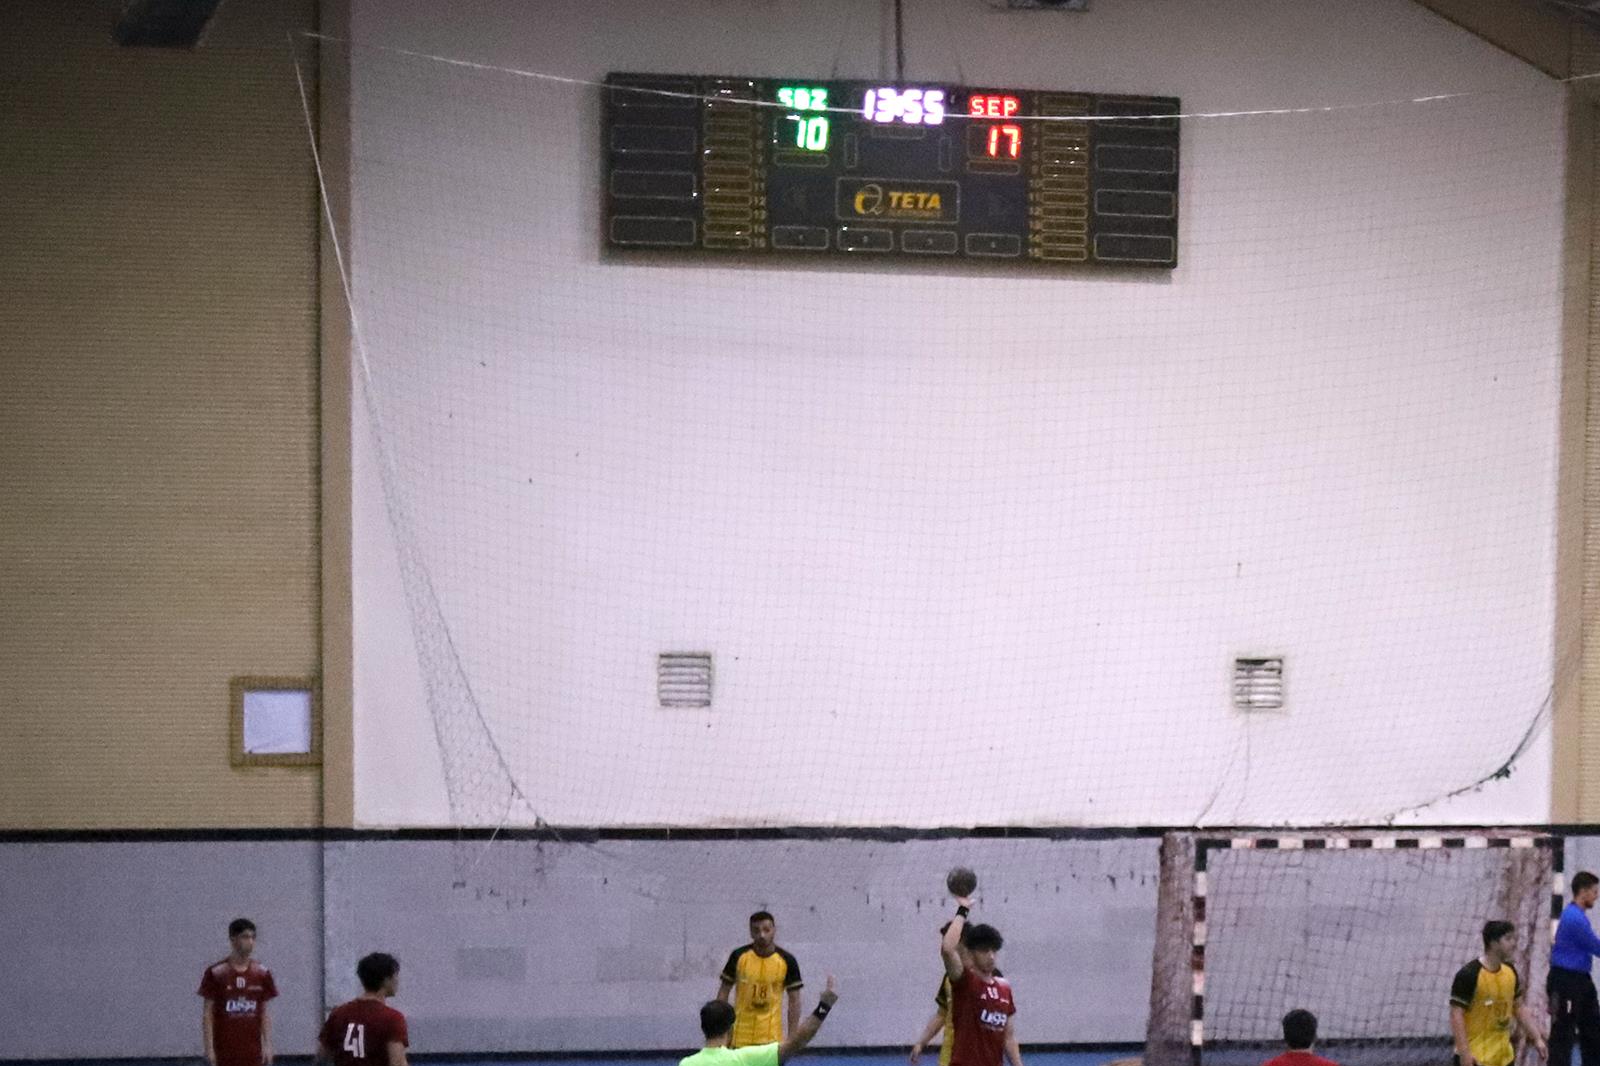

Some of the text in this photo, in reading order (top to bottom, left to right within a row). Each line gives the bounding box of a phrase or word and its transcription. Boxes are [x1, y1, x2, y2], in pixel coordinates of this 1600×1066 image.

[969, 96, 1018, 117] SEP
[796, 117, 829, 151] 10
[987, 124, 1020, 158] 17
[887, 191, 942, 209] TETA
[343, 1022, 365, 1059] 41
